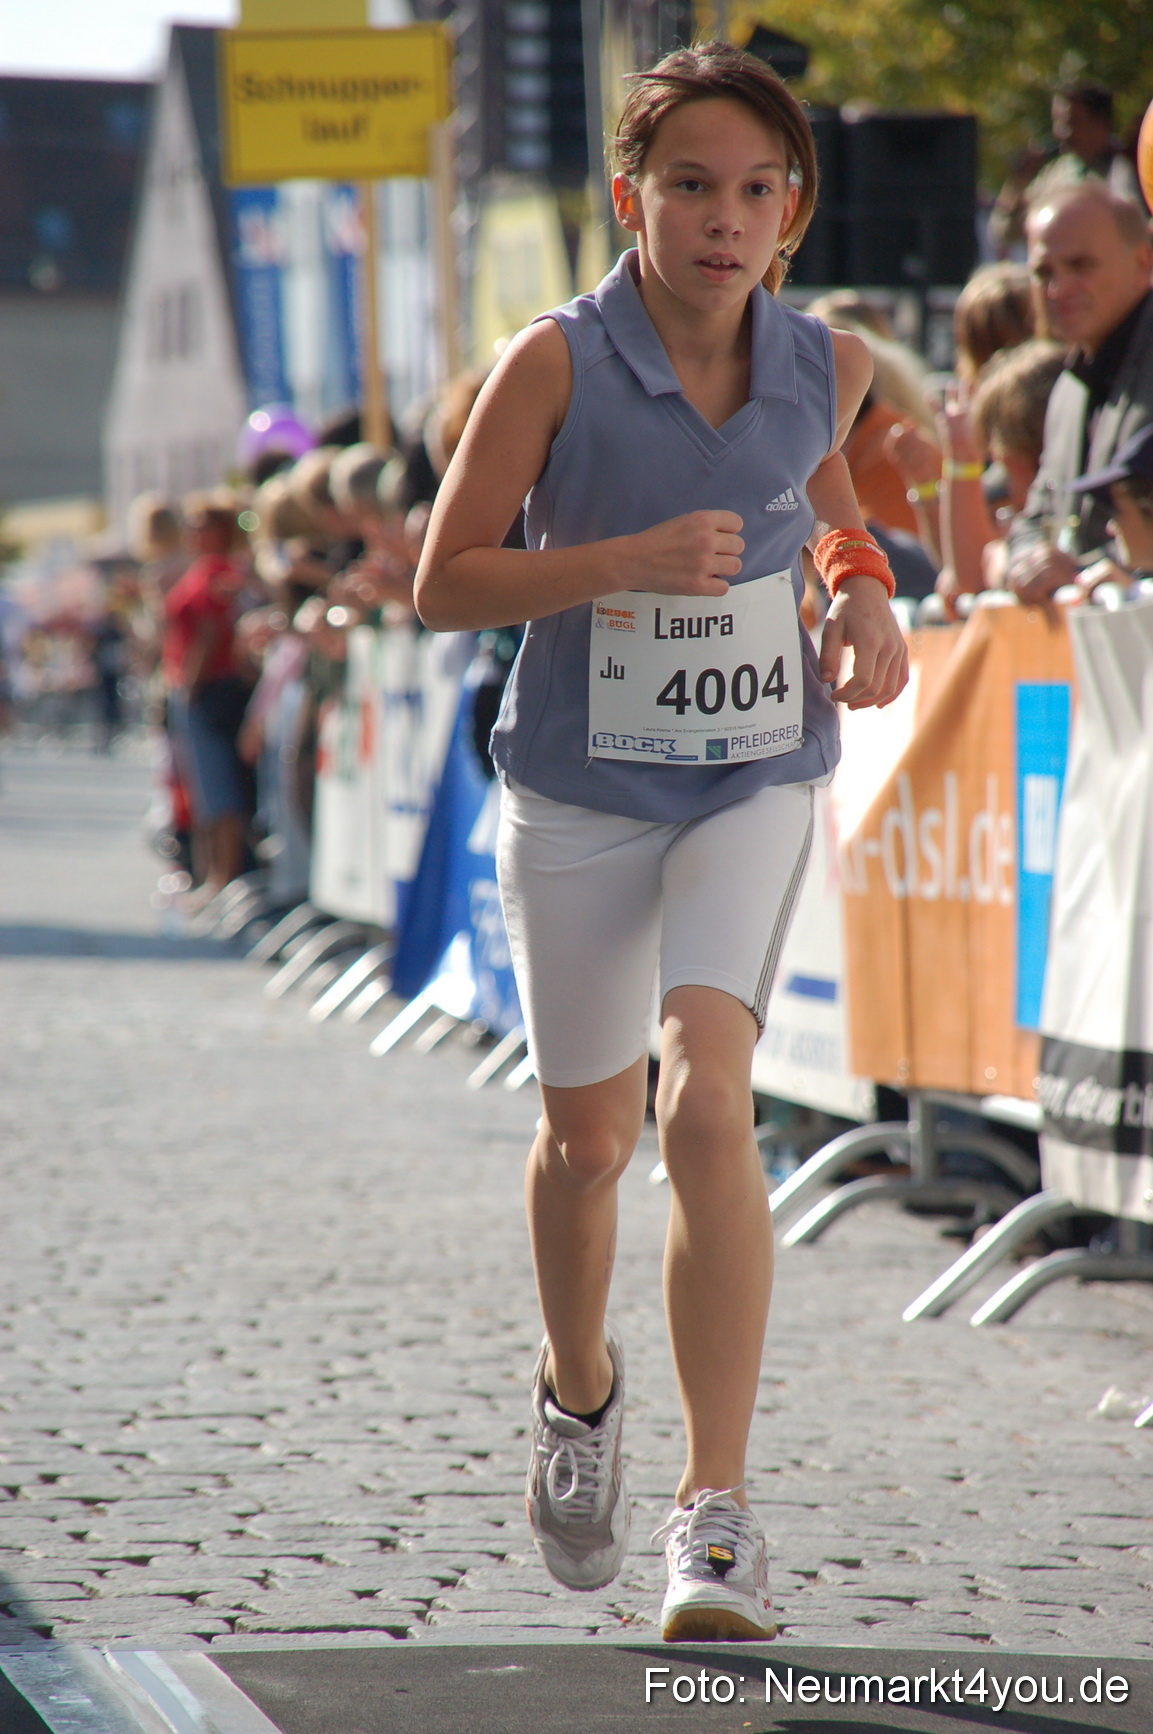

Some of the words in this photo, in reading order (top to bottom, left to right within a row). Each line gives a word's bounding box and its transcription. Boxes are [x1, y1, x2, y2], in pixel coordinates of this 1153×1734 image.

[766, 502, 799, 512] adidas
[595, 618, 605, 629] &
[654, 607, 734, 640] Laura
[599, 656, 625, 680] Ju
[655, 655, 789, 716] 4004
[592, 732, 677, 756] BOCK
[730, 723, 800, 751] PFLEIDERER
